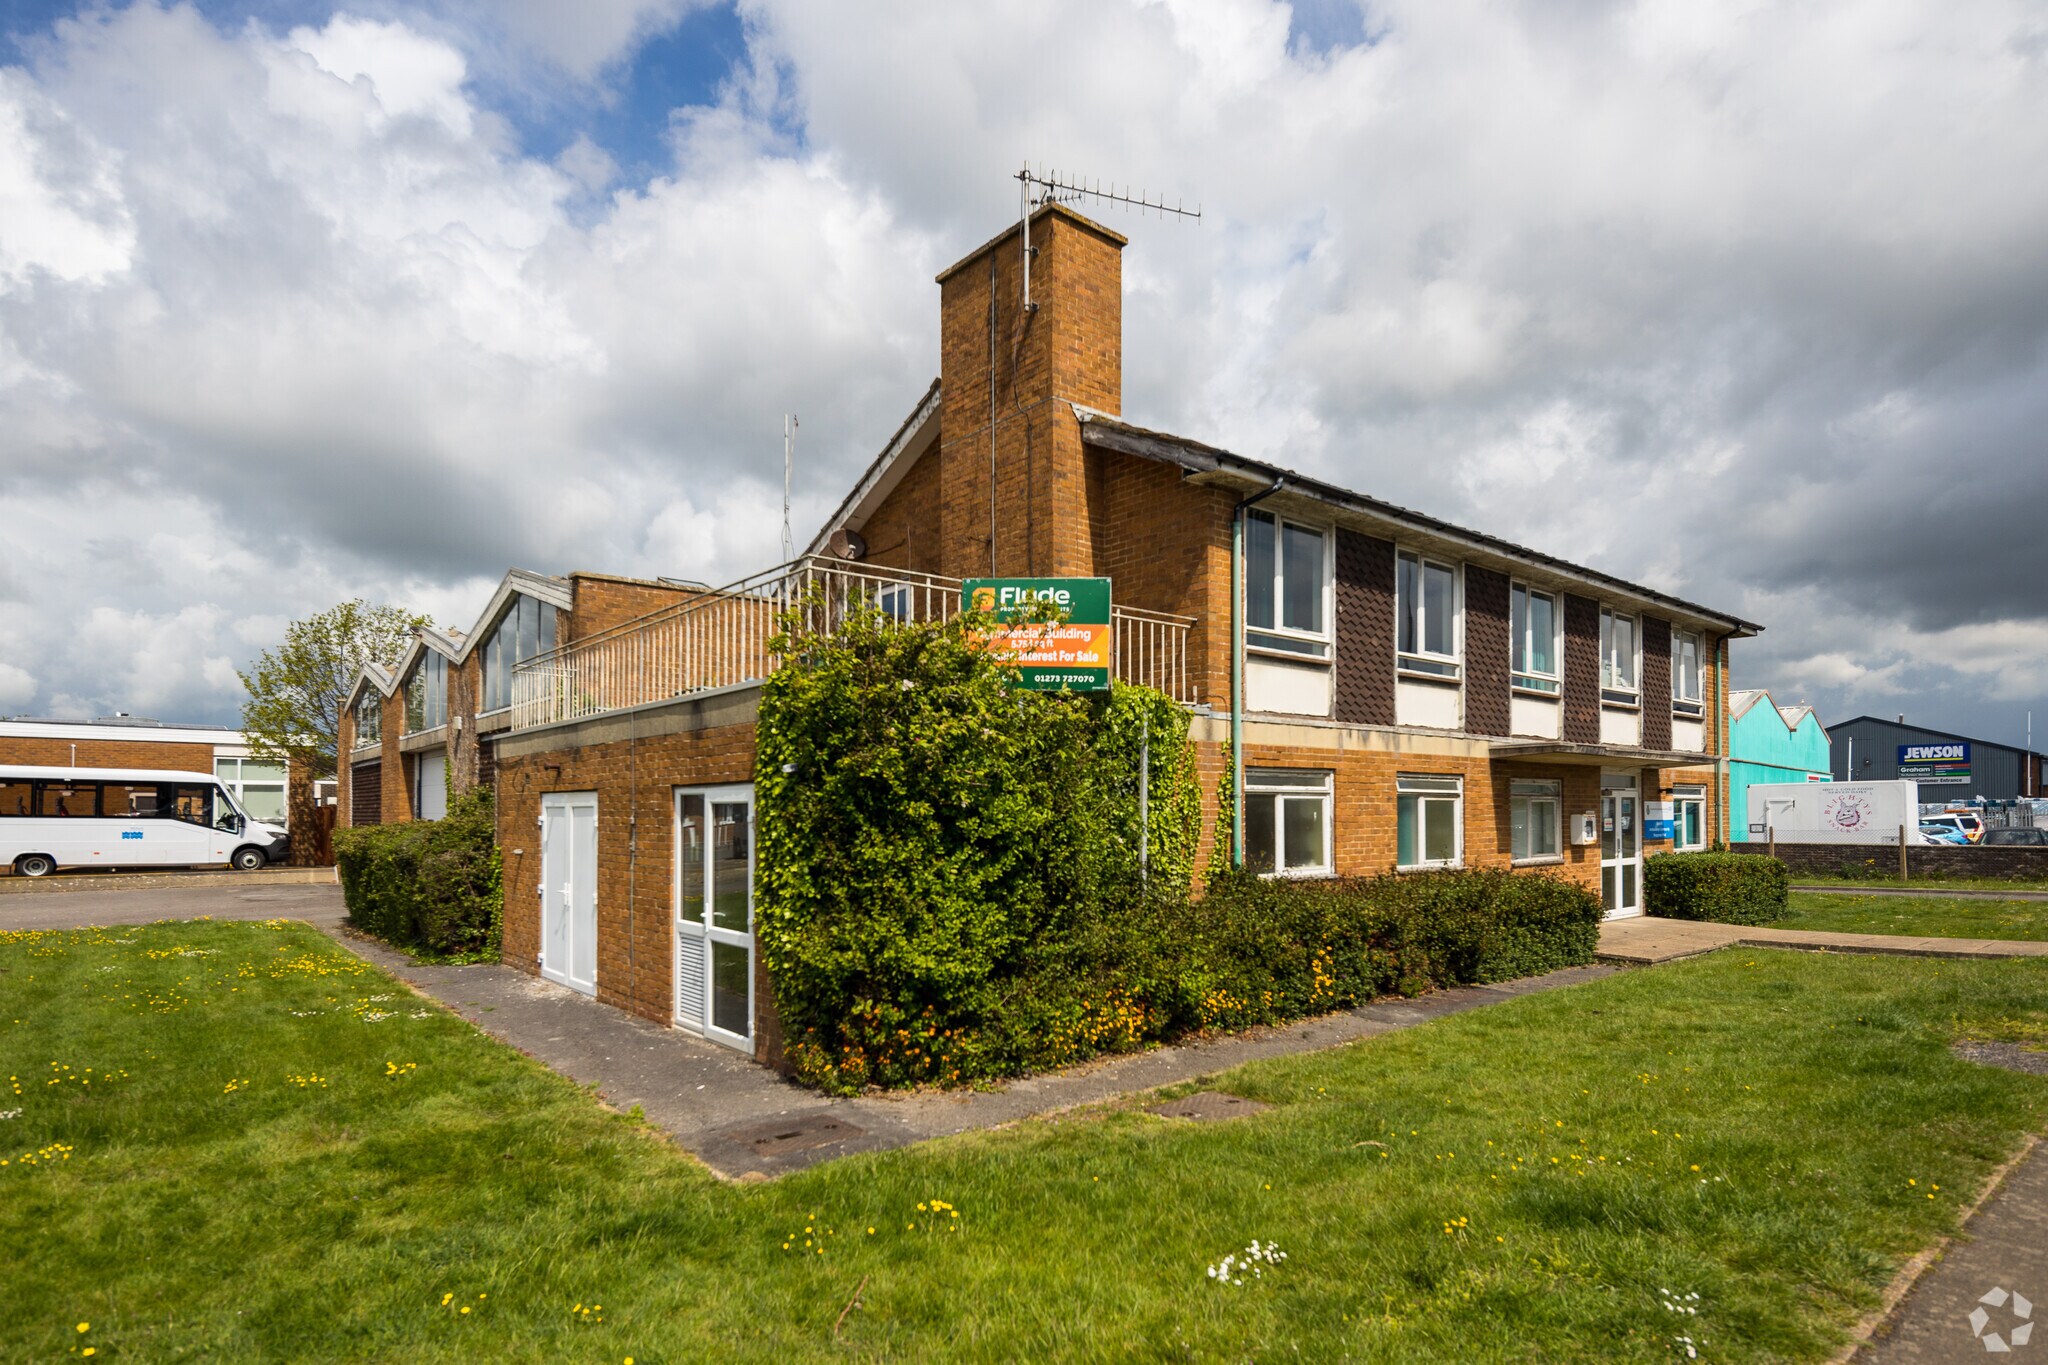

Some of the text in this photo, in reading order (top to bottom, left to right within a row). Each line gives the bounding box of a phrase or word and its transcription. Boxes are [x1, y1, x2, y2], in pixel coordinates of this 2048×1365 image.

[1046, 639, 1054, 647] ft
[1059, 650, 1075, 661] For
[1076, 650, 1099, 662] Sale
[1034, 675, 1061, 683] 01273
[1062, 675, 1095, 683] 727070
[1904, 745, 1964, 759] JEWSON
